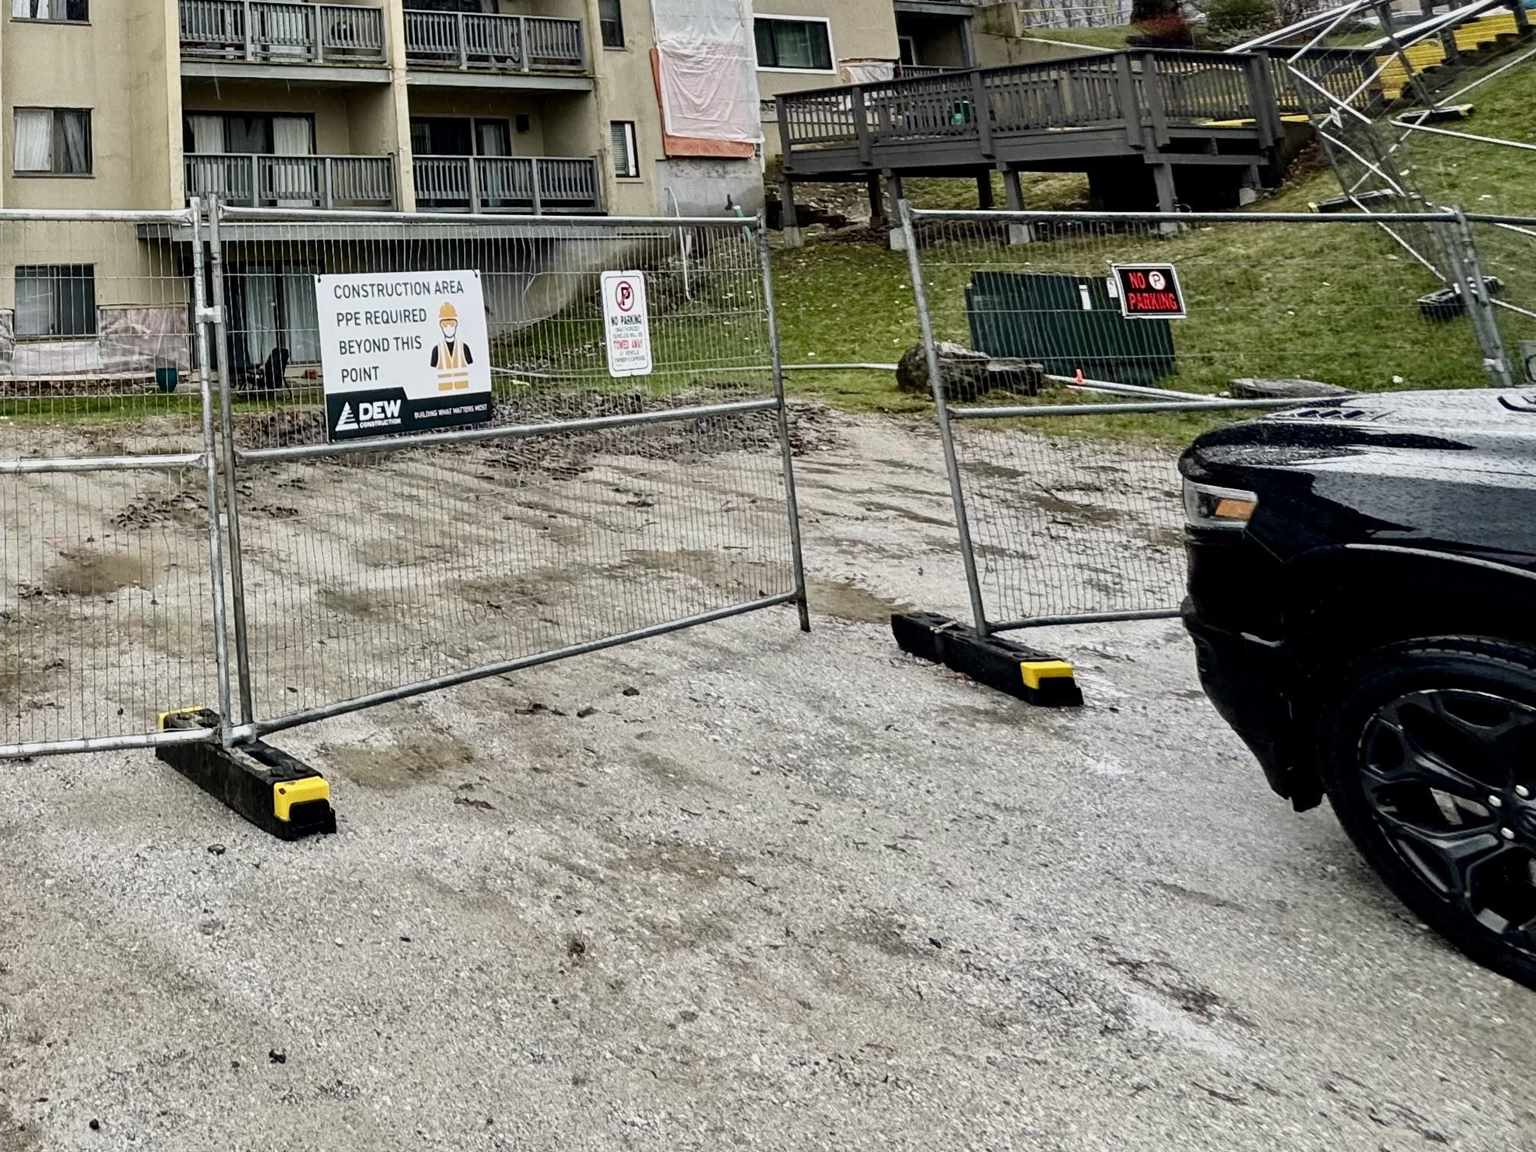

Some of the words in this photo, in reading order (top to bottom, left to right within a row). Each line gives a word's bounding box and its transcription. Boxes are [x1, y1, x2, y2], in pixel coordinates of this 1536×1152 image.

[1128, 272, 1146, 288] NO
[333, 281, 431, 299] CONSTRUCTION
[434, 280, 464, 295] AREA
[1127, 292, 1178, 310] PARKING
[336, 311, 361, 327] PPE
[365, 308, 427, 325] REQUIRED
[611, 315, 618, 326] NO
[621, 314, 642, 325] PARKING
[339, 337, 390, 355] BEYOND
[393, 335, 422, 351] THIS
[341, 366, 379, 383] POINT
[358, 400, 402, 421] DEW
[414, 409, 437, 419] BUILDING
[438, 408, 452, 416] WHAT
[452, 405, 474, 414] MATTERS
[474, 403, 488, 411] MOST
[359, 418, 402, 429] CONSTRUCTION
